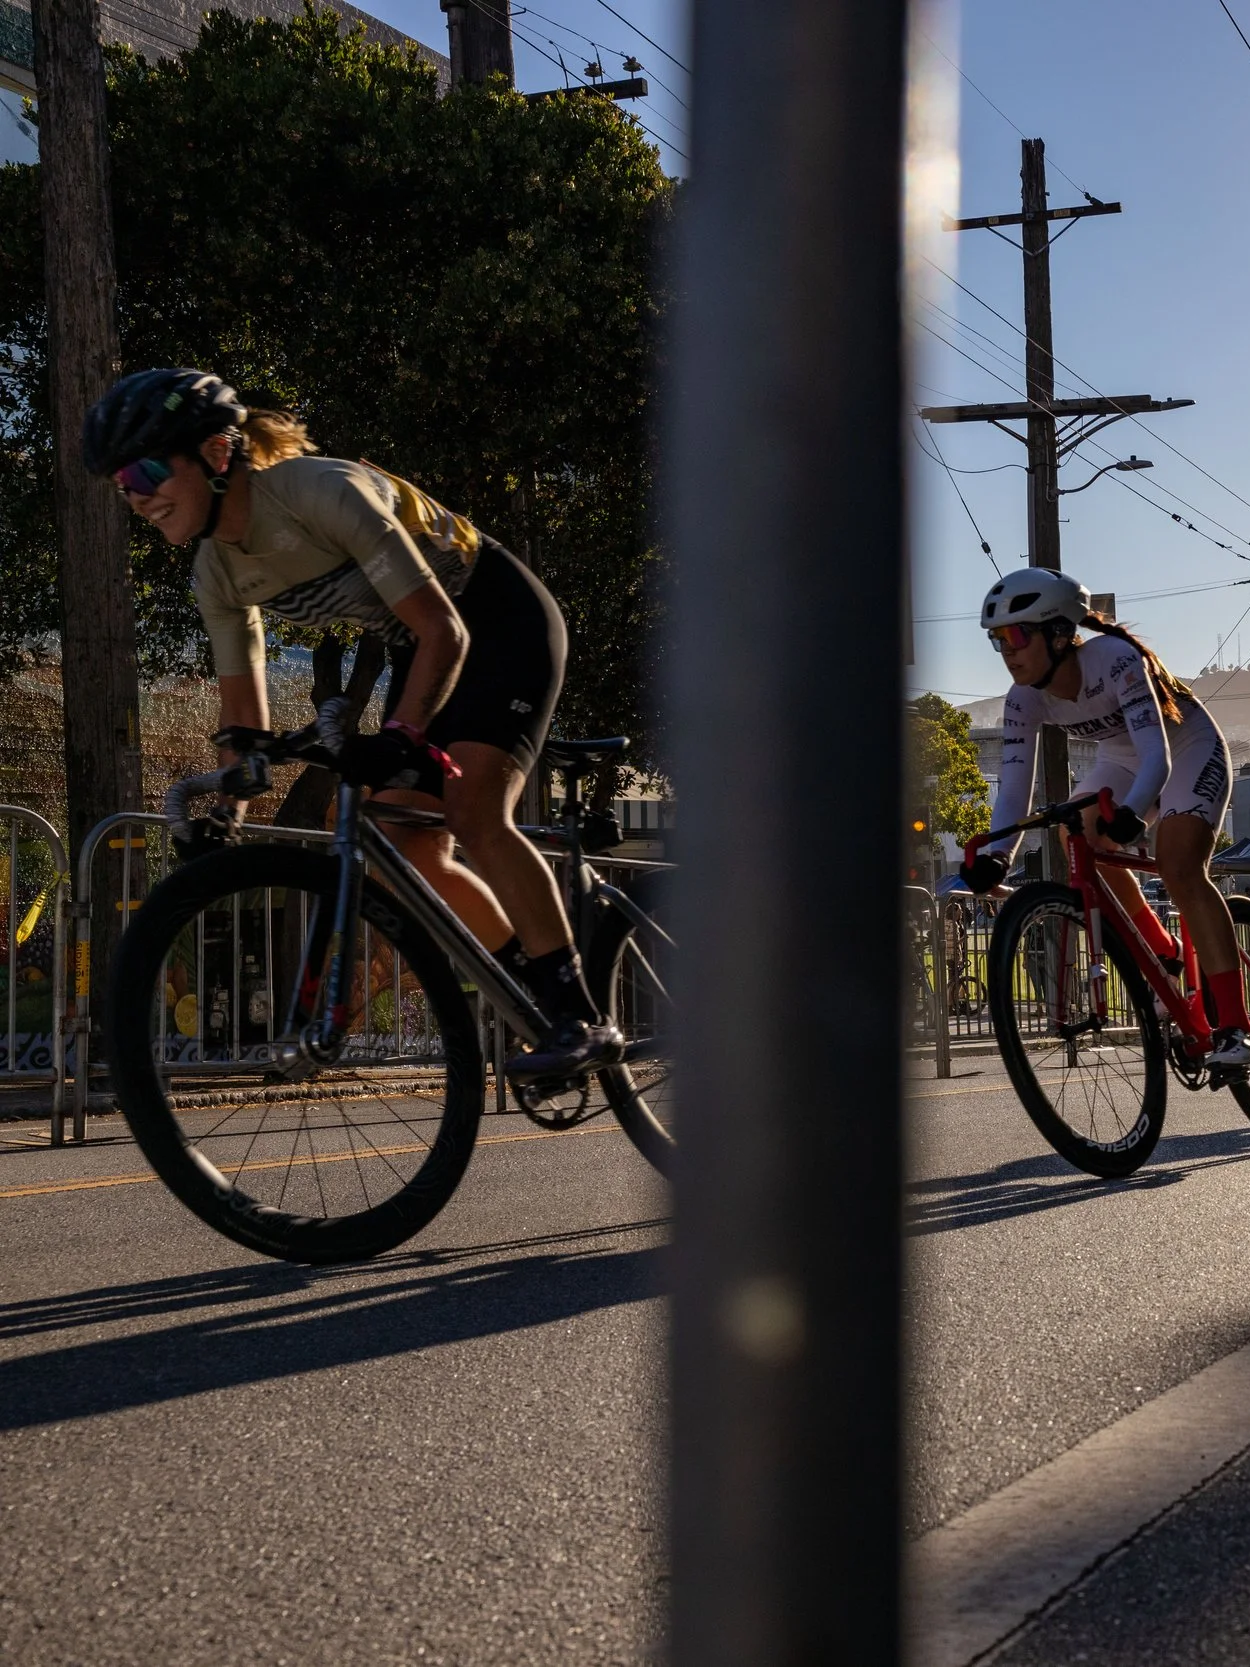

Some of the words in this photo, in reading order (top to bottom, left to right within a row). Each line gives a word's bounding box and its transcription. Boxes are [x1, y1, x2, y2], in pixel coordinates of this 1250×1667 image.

[1192, 757, 1226, 804] SYSTEM
[1020, 902, 1085, 931] CORIM
[1086, 1113, 1150, 1153] CORIM
